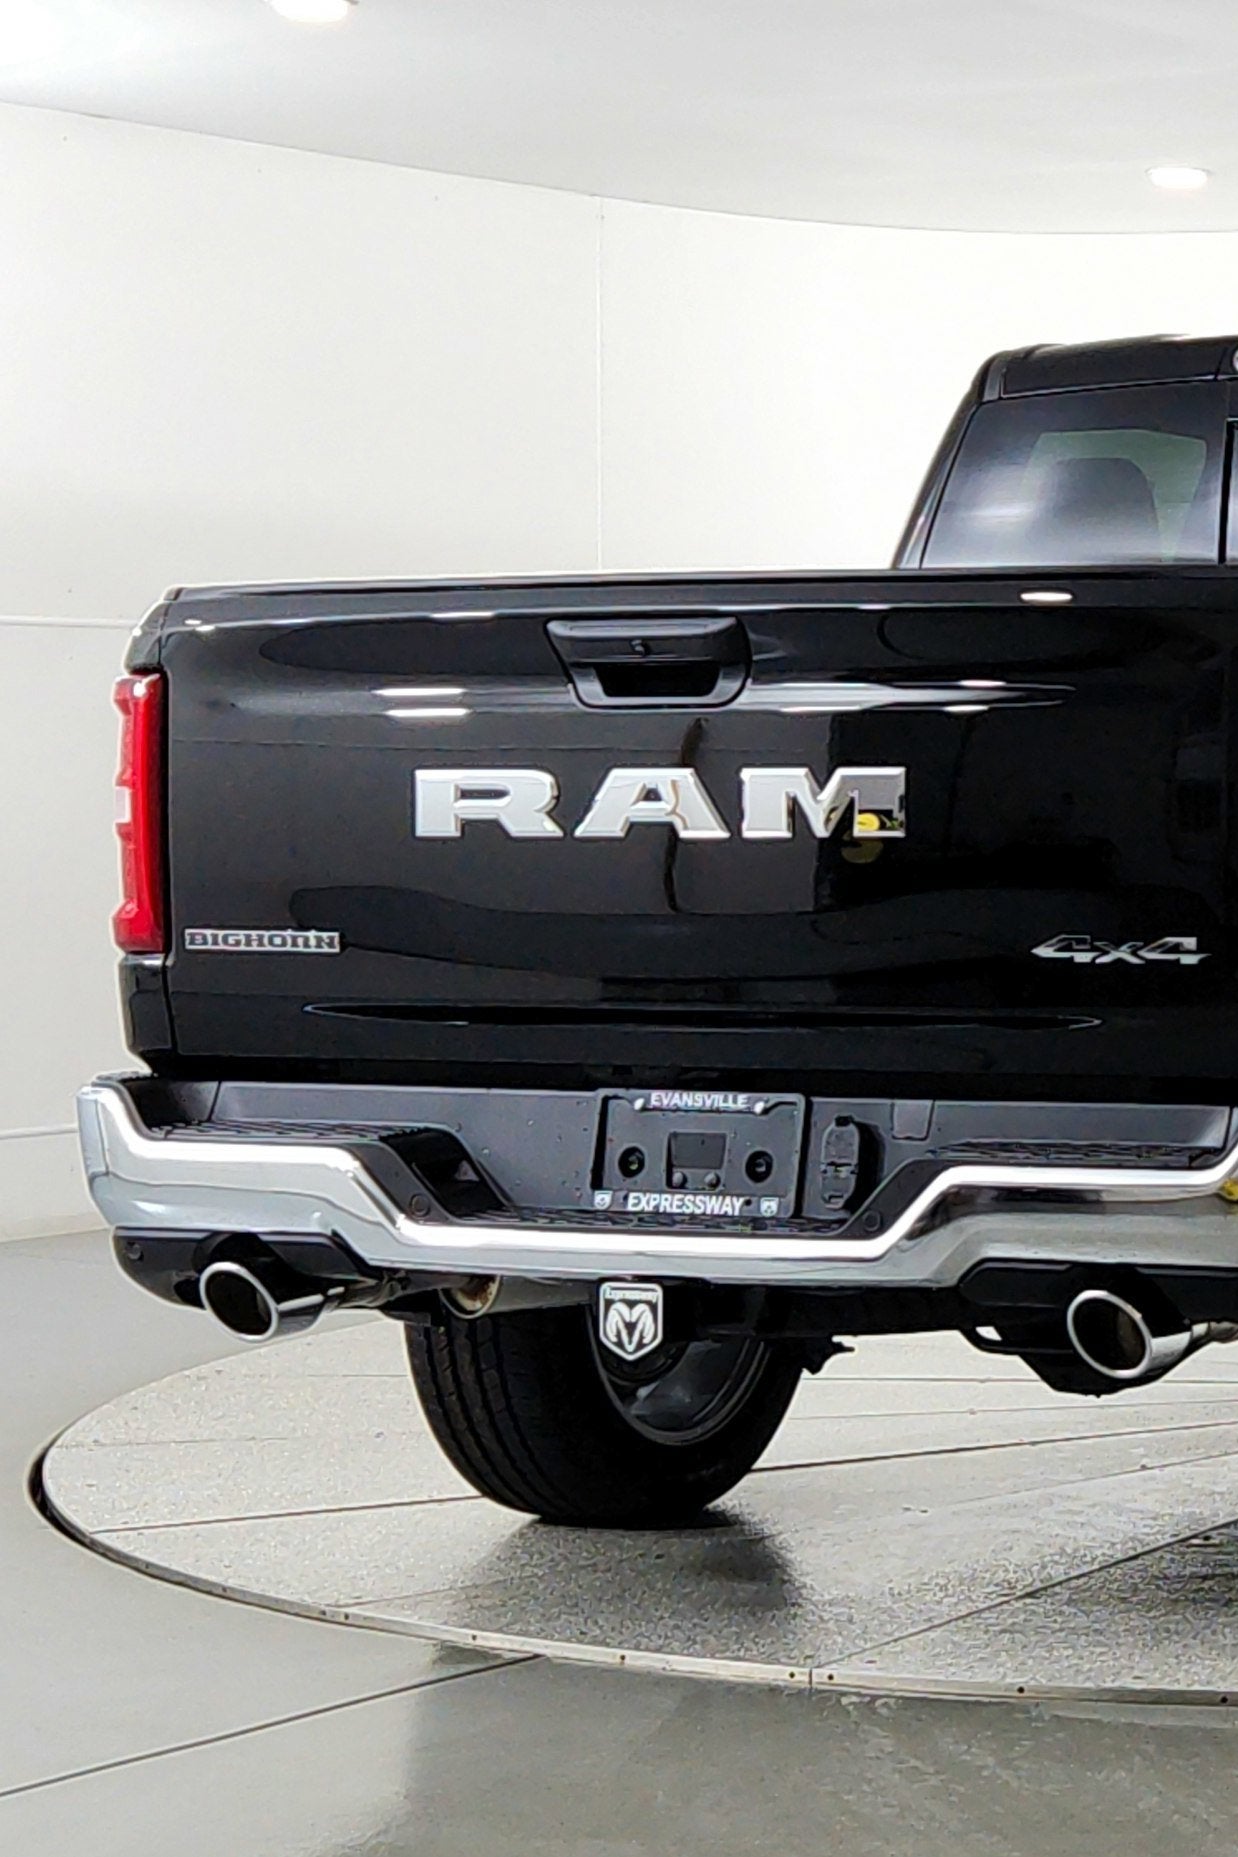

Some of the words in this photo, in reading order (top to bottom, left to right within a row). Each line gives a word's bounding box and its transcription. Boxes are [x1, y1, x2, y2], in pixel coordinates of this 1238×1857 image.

[413, 765, 906, 839] RAM
[185, 929, 340, 953] BIGHORN
[649, 1091, 750, 1109] EVANSVILLE
[626, 1192, 745, 1216] EXPRESSWAY
